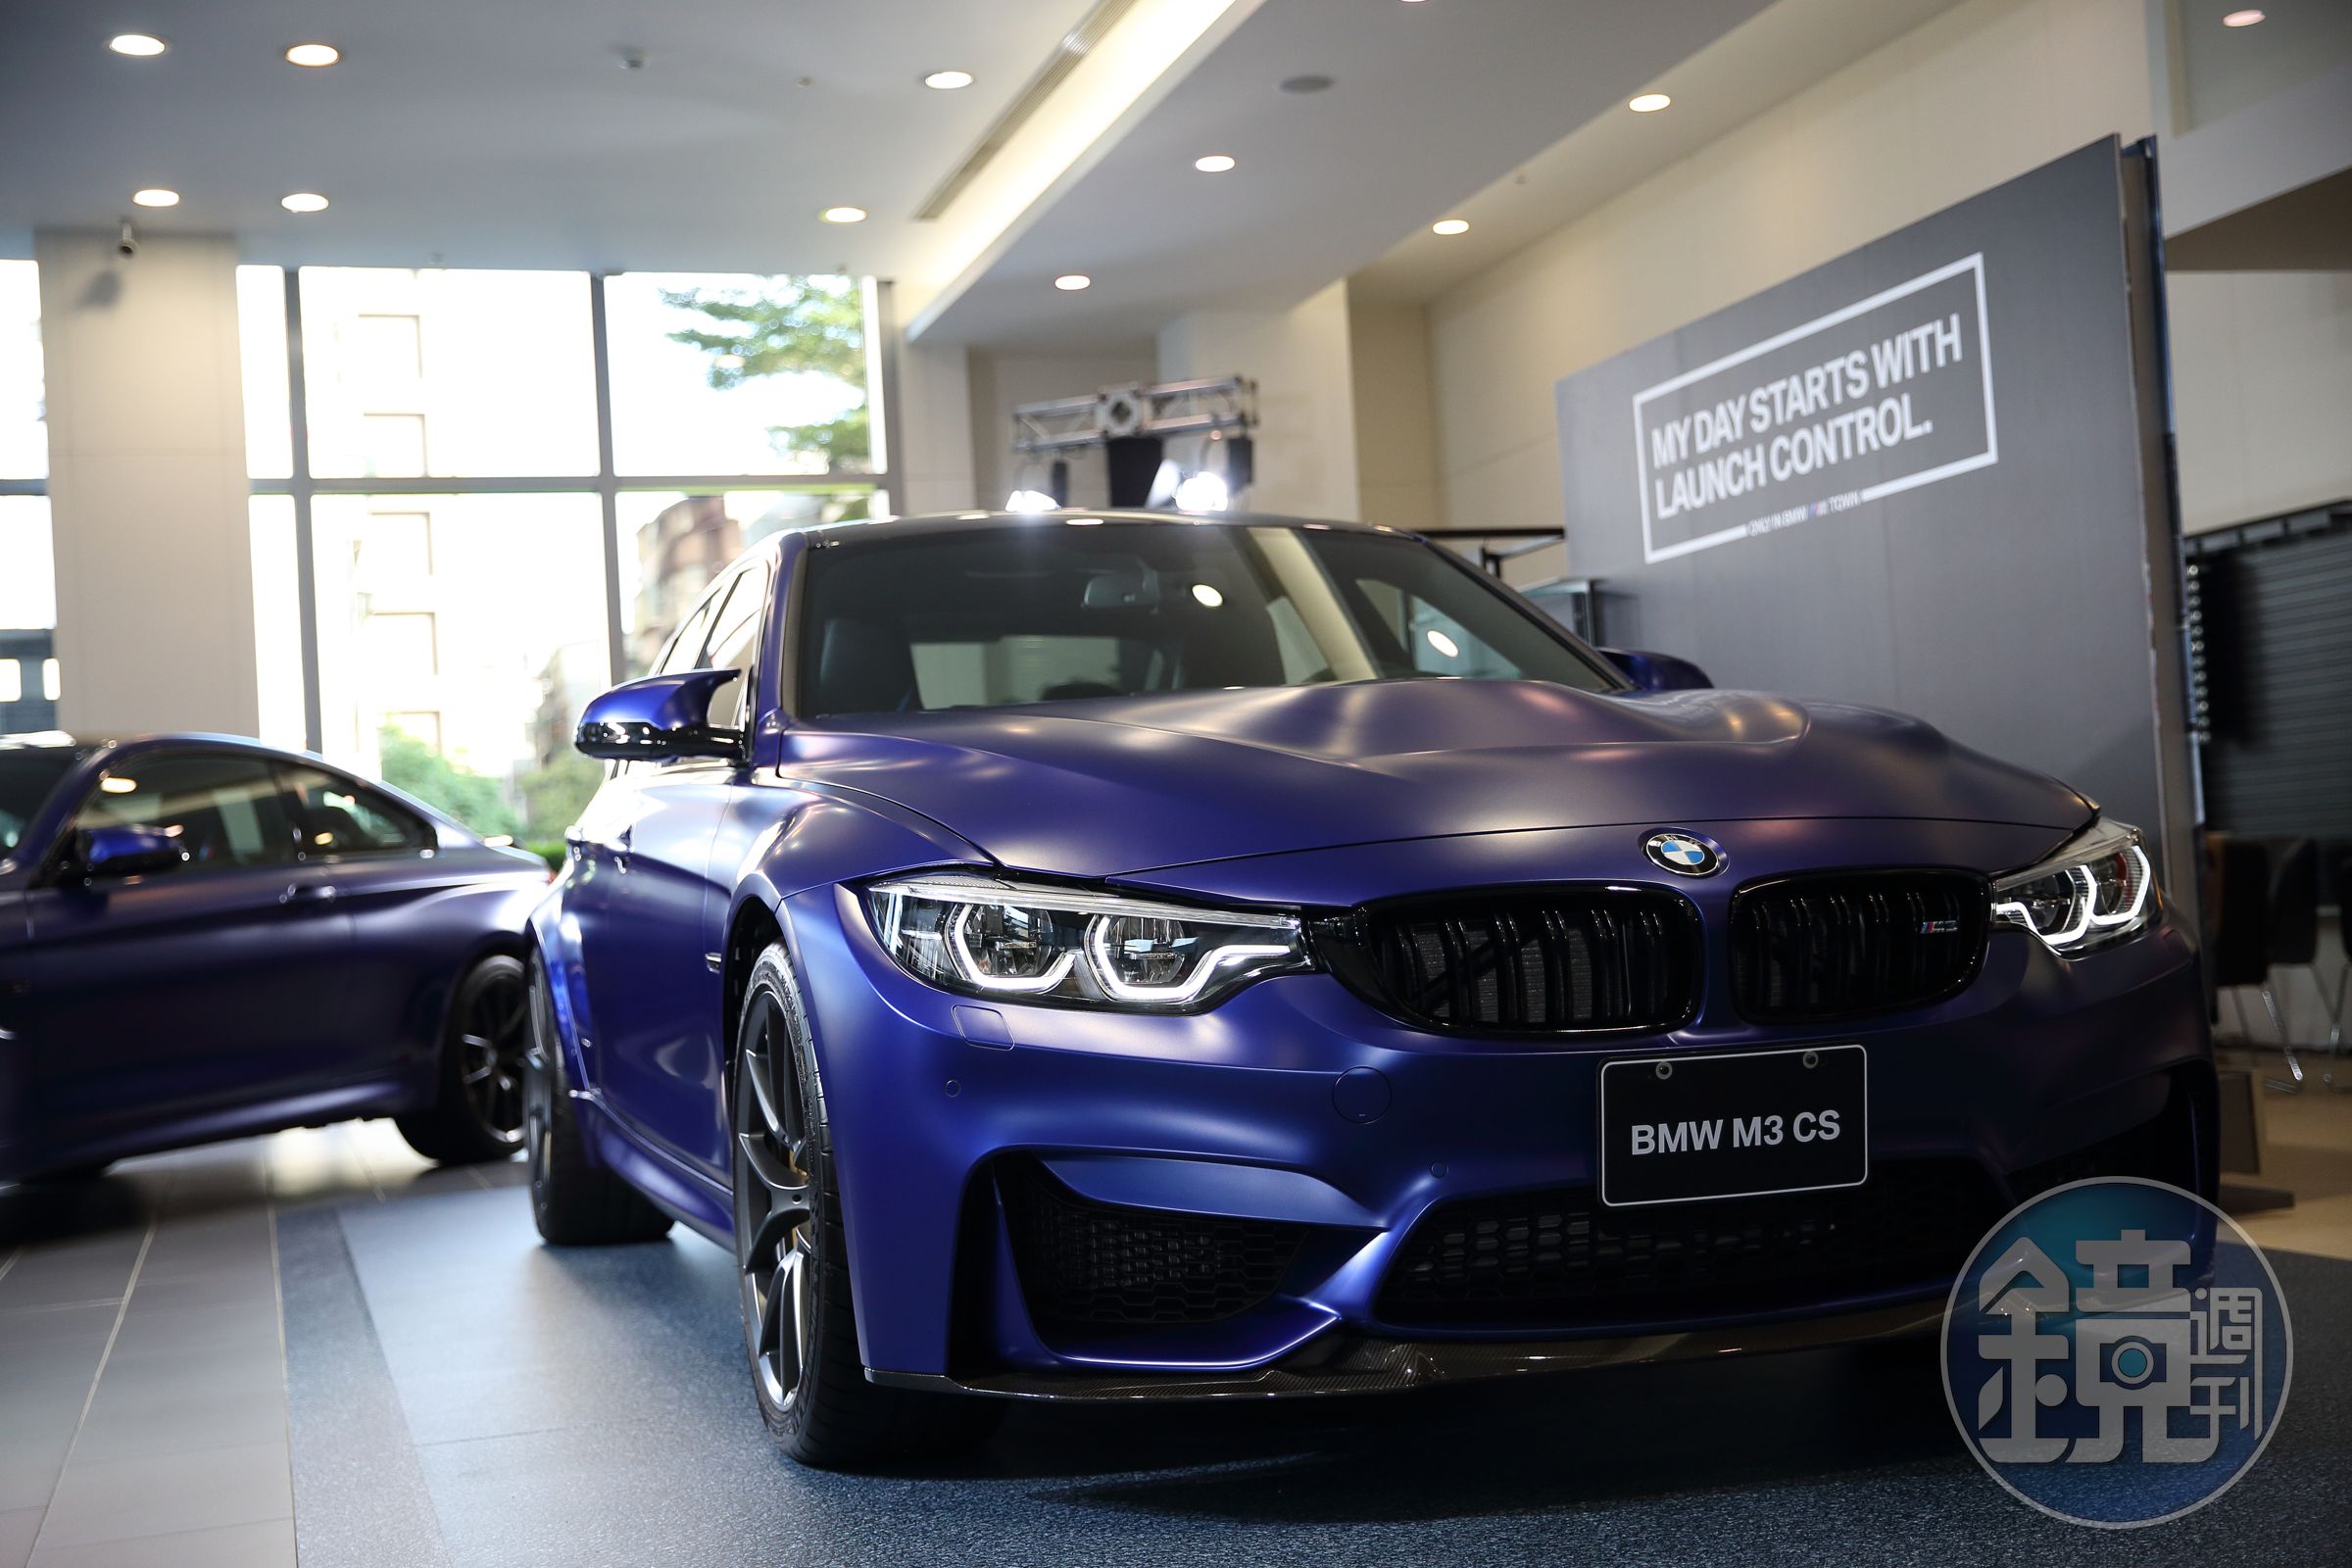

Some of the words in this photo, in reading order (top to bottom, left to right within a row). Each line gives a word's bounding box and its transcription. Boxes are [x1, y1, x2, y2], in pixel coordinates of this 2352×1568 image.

[1651, 415, 1691, 469] MY
[1693, 394, 1746, 454] DAY
[1749, 350, 1870, 433] STARTS
[1871, 313, 1962, 388] WITH
[1655, 444, 1766, 519] LAUNCH
[1770, 392, 1934, 481] CONTROL.
[1631, 1119, 1724, 1155] BMW
[1733, 1114, 1784, 1148] M3
[1792, 1109, 1840, 1143] CS
